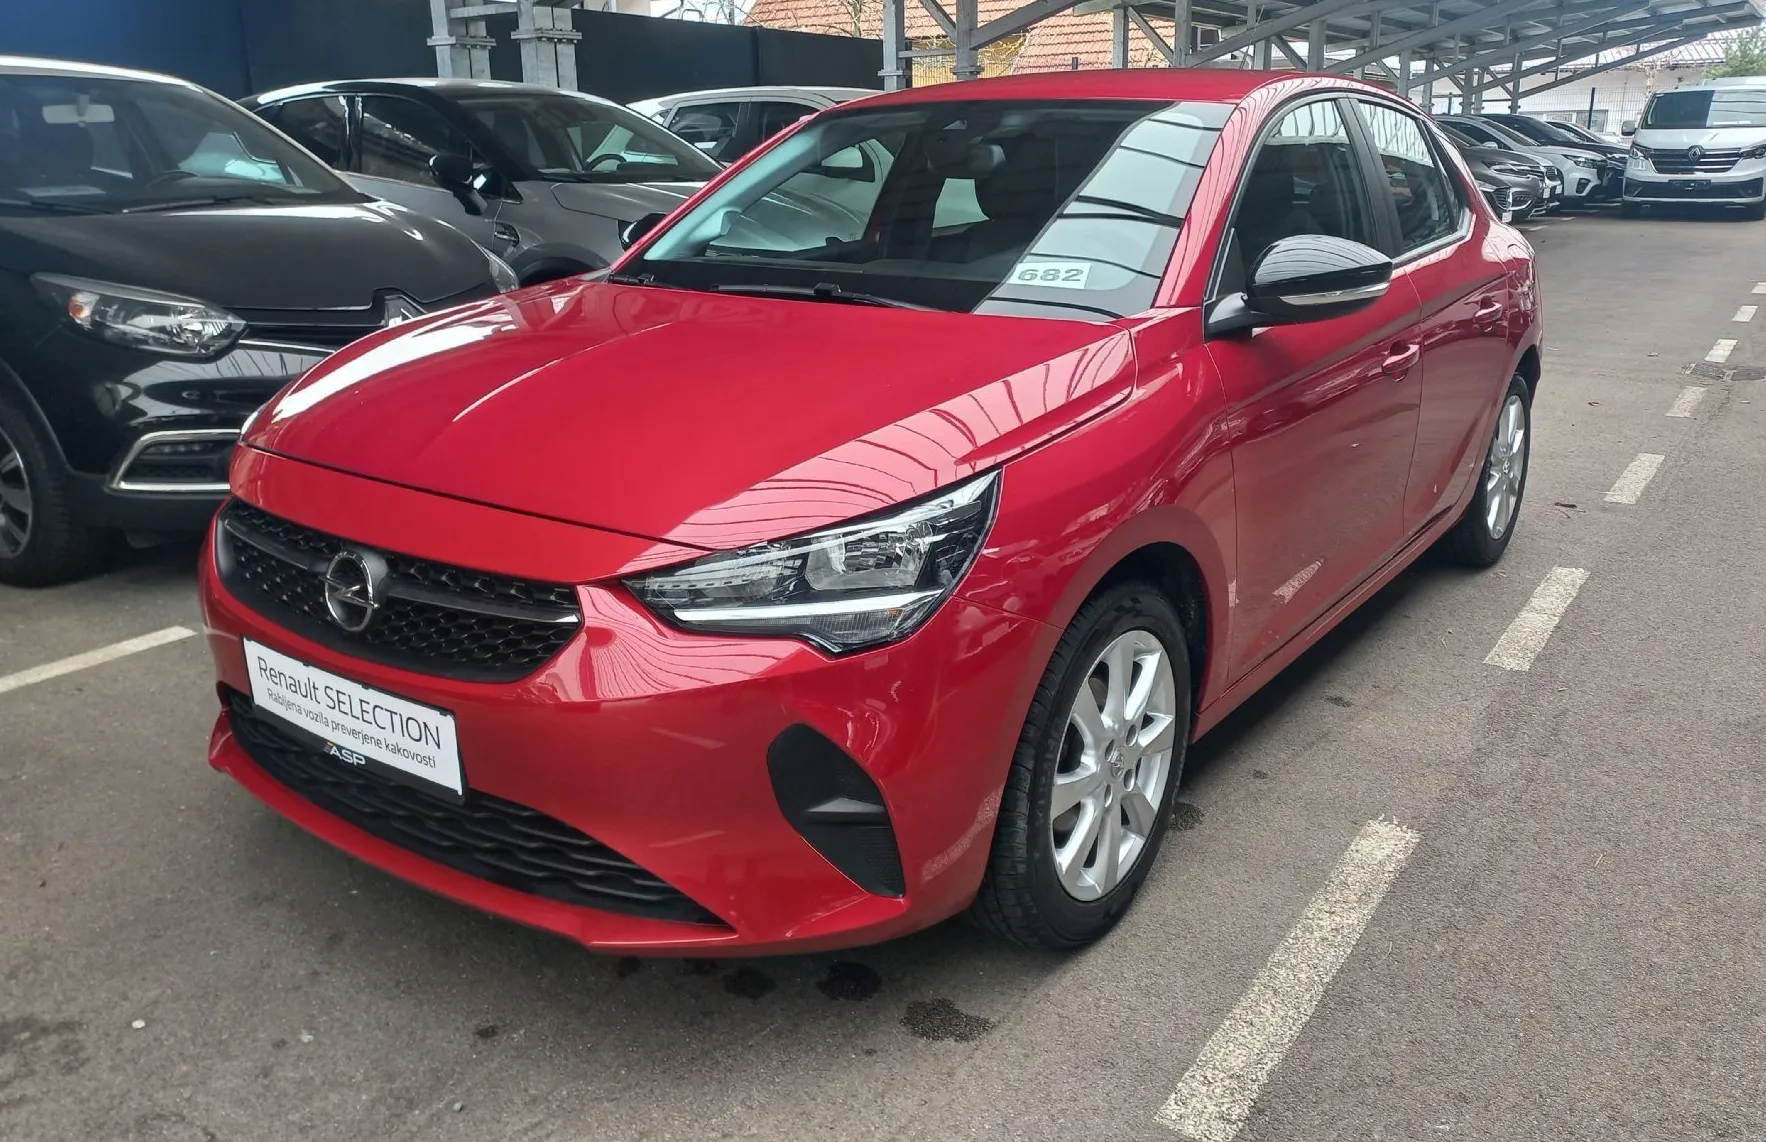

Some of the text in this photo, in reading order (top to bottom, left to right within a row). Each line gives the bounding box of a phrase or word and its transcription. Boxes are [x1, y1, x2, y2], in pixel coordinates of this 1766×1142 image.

[1018, 268, 1084, 282] 682
[257, 656, 442, 750] Renault SELECTION
[267, 688, 436, 769] Rabljena vozila preverjene kakovosti
[329, 745, 366, 766] ASP
